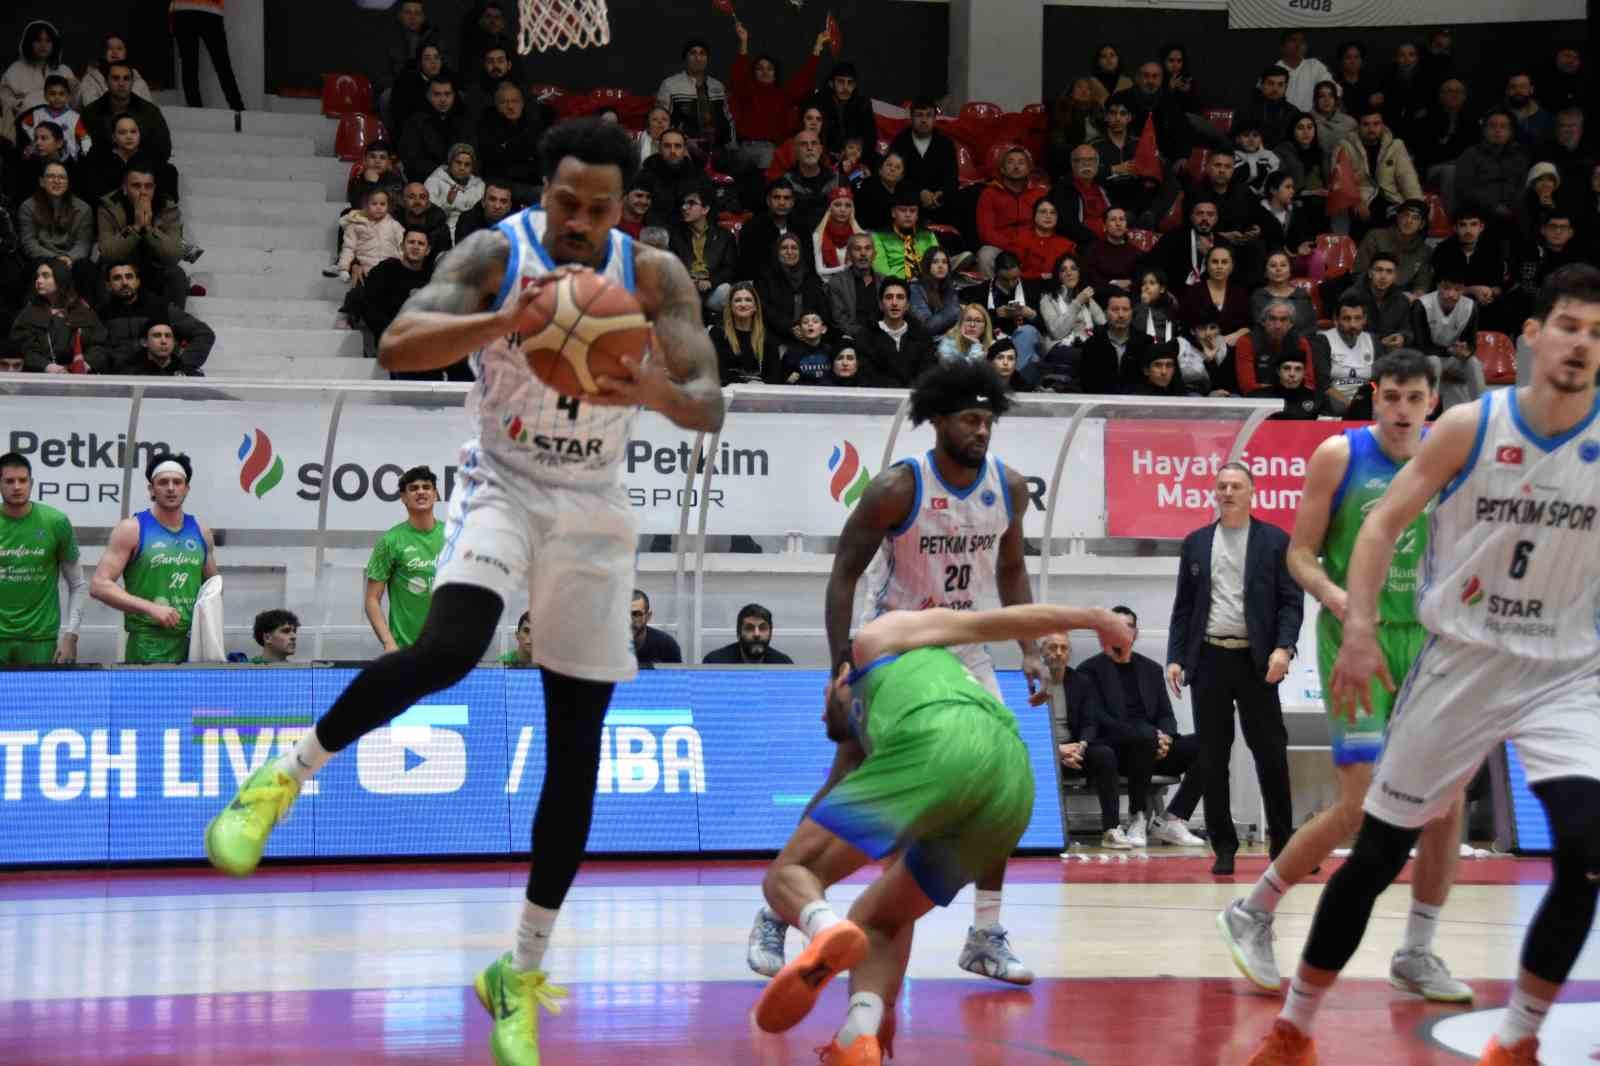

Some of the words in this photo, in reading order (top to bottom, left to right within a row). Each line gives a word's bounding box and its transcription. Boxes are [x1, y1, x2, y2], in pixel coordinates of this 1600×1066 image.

[534, 433, 604, 457] STAR
[627, 440, 769, 476] Petkim
[1132, 449, 1222, 482] Hayat
[38, 482, 121, 503] POR
[296, 463, 458, 502] SOC
[629, 488, 725, 508] SPOR
[1157, 483, 1304, 510] Maxum
[1509, 540, 1536, 580] 6
[944, 564, 972, 592] 20
[1488, 594, 1544, 619] STAR
